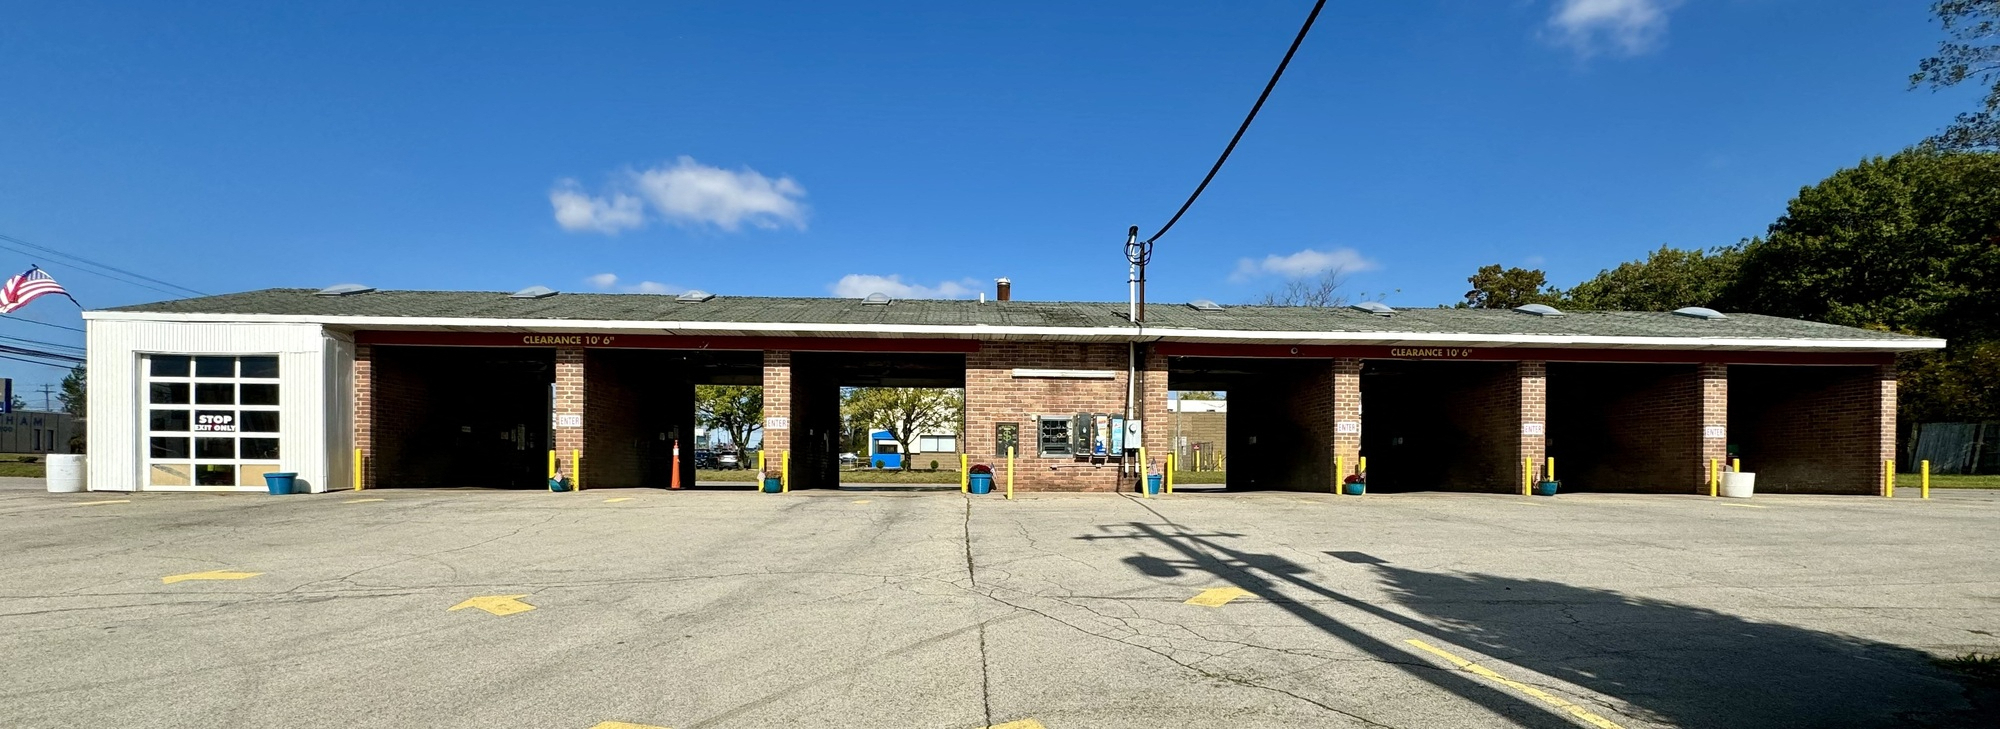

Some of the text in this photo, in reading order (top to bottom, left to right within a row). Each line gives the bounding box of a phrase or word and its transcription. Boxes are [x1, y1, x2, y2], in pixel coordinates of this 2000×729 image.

[523, 336, 615, 345] CLEARANCE 10' 6"
[1391, 348, 1472, 358] CLEARANCE 10' 6"
[199, 414, 232, 424] STOP
[560, 416, 580, 425] ENTER
[768, 419, 786, 428] ENTER
[1338, 424, 1356, 432] ENTER
[1706, 428, 1723, 436] ENTER
